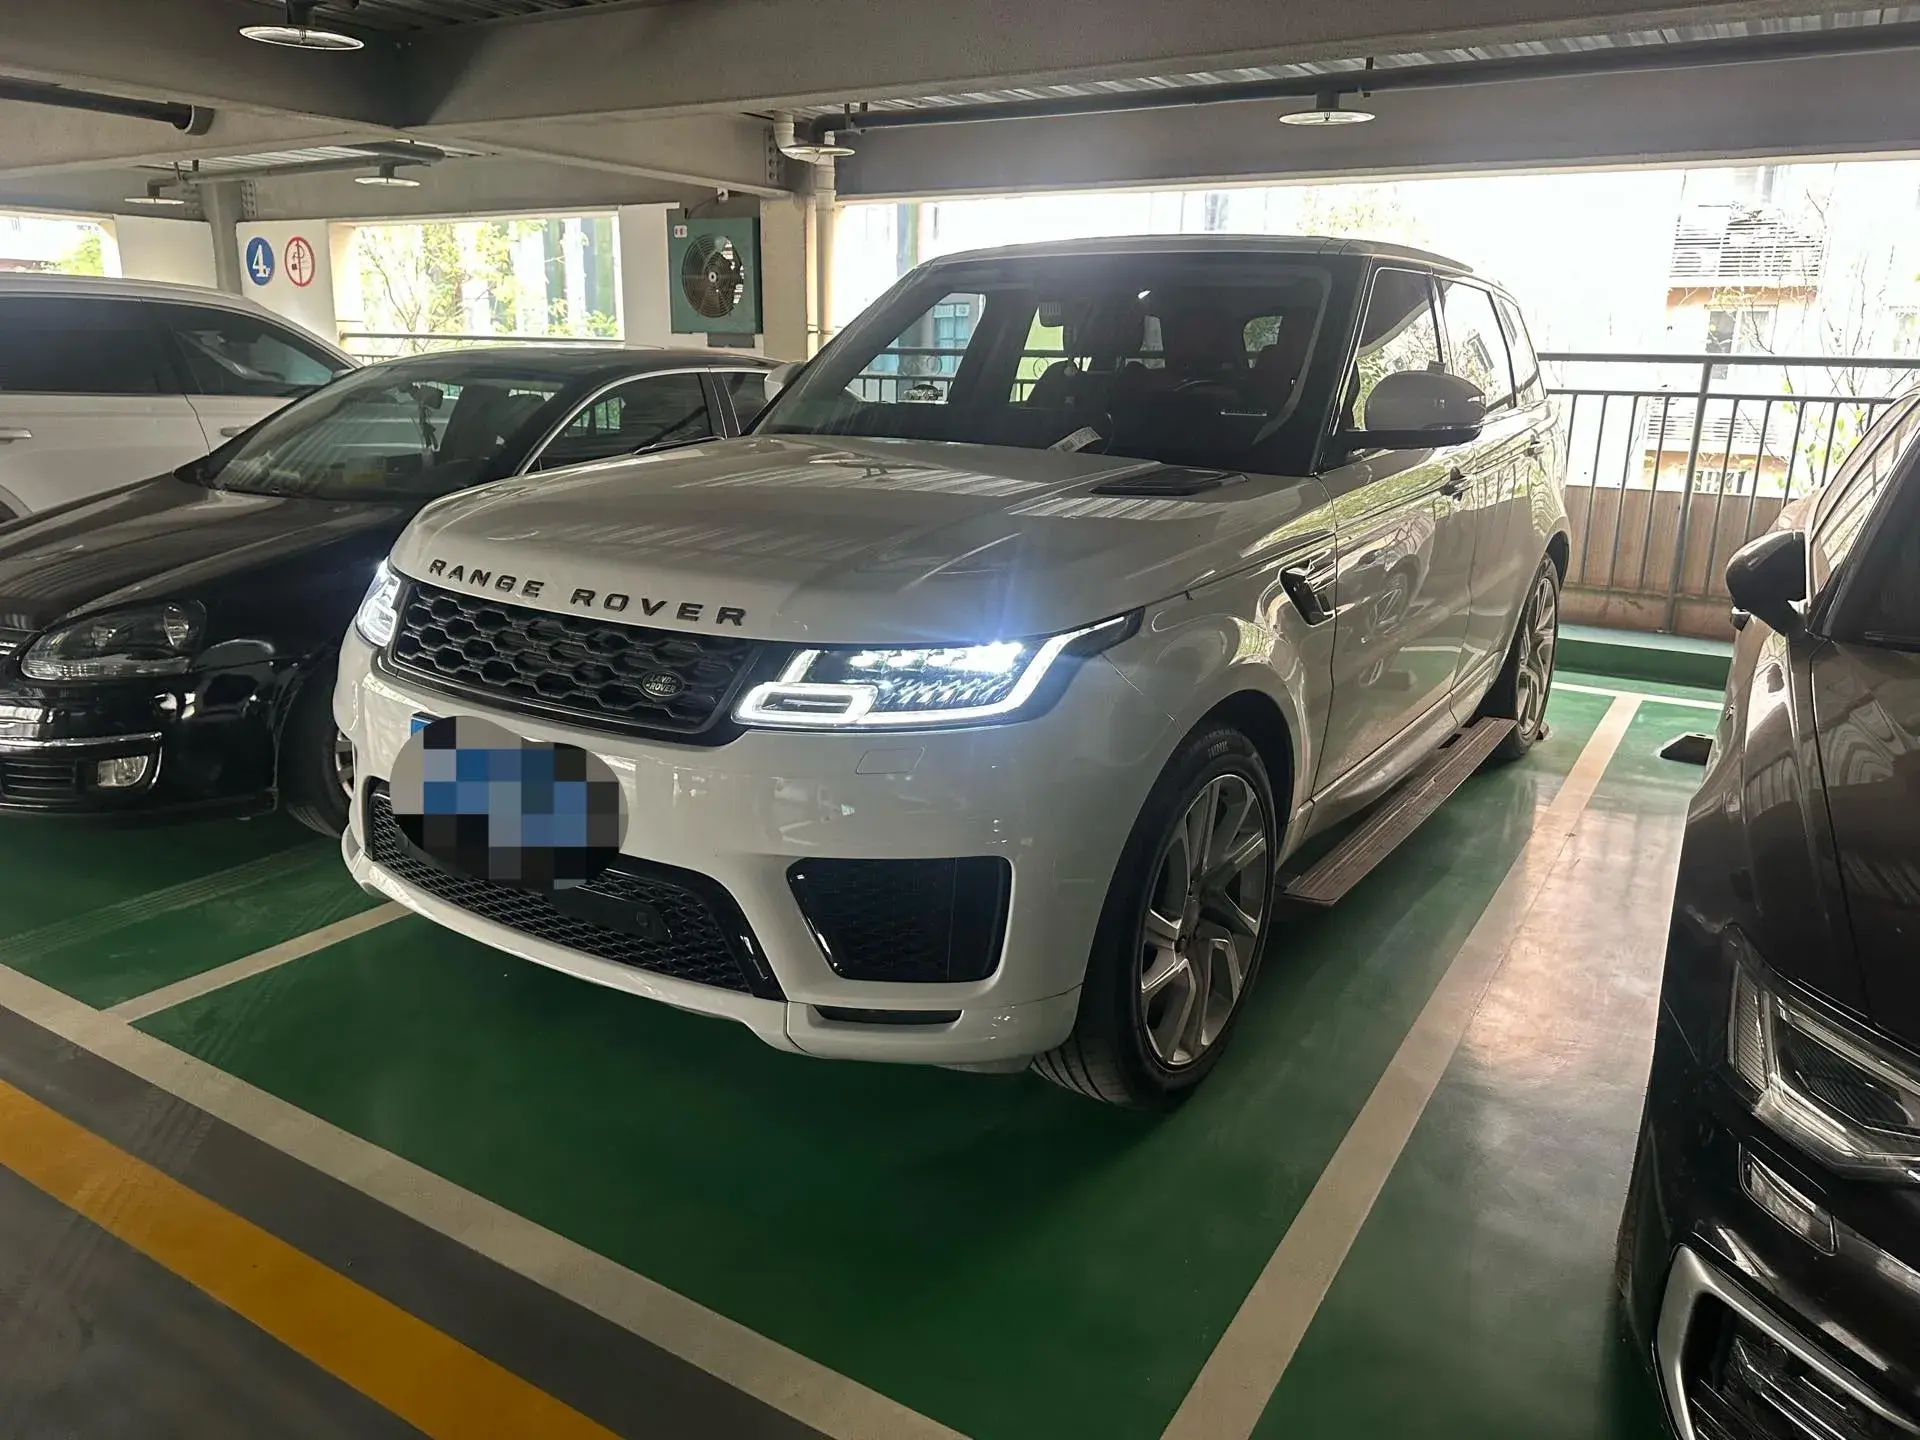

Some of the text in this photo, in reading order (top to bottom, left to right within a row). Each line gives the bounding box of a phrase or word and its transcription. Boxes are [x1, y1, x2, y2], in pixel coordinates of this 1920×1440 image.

[428, 558, 747, 626] RANGE ROVER
[649, 674, 672, 683] LAND
[649, 682, 676, 693] ROVER
